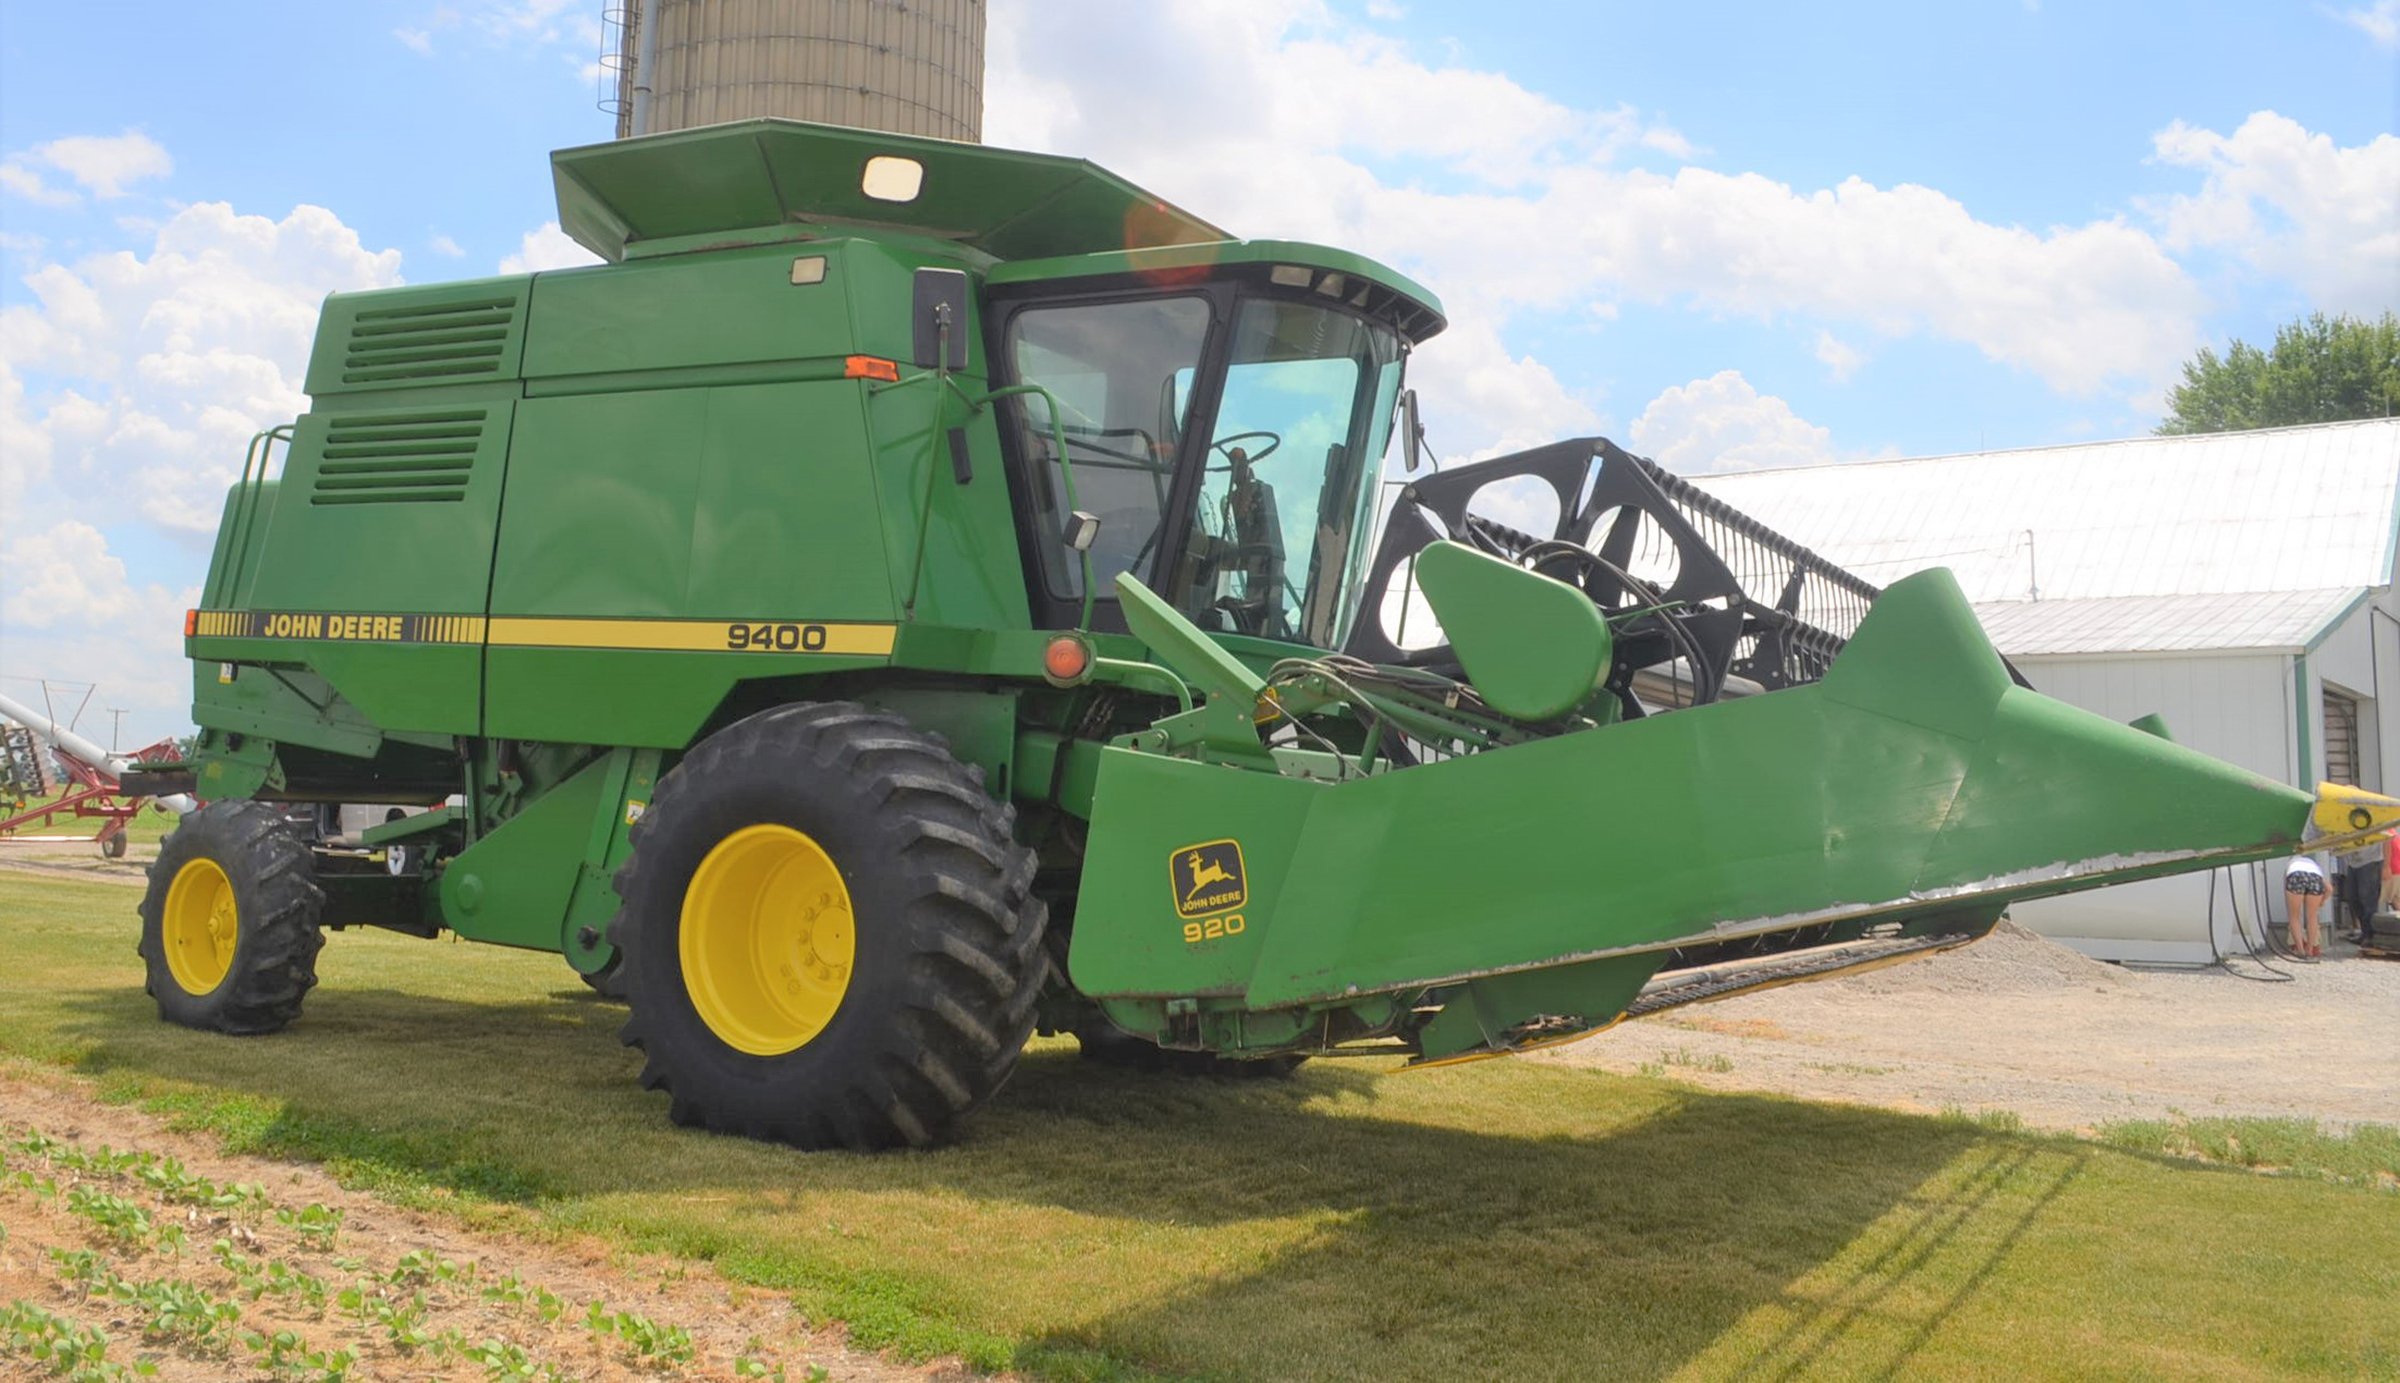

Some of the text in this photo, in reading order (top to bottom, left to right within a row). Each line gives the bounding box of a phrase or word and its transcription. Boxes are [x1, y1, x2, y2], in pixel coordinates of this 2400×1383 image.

[264, 614, 403, 640] JOHN DEERE
[727, 624, 827, 650] 9400
[1182, 890, 1241, 912] JOHN DEERE
[1183, 914, 1245, 943] 920
